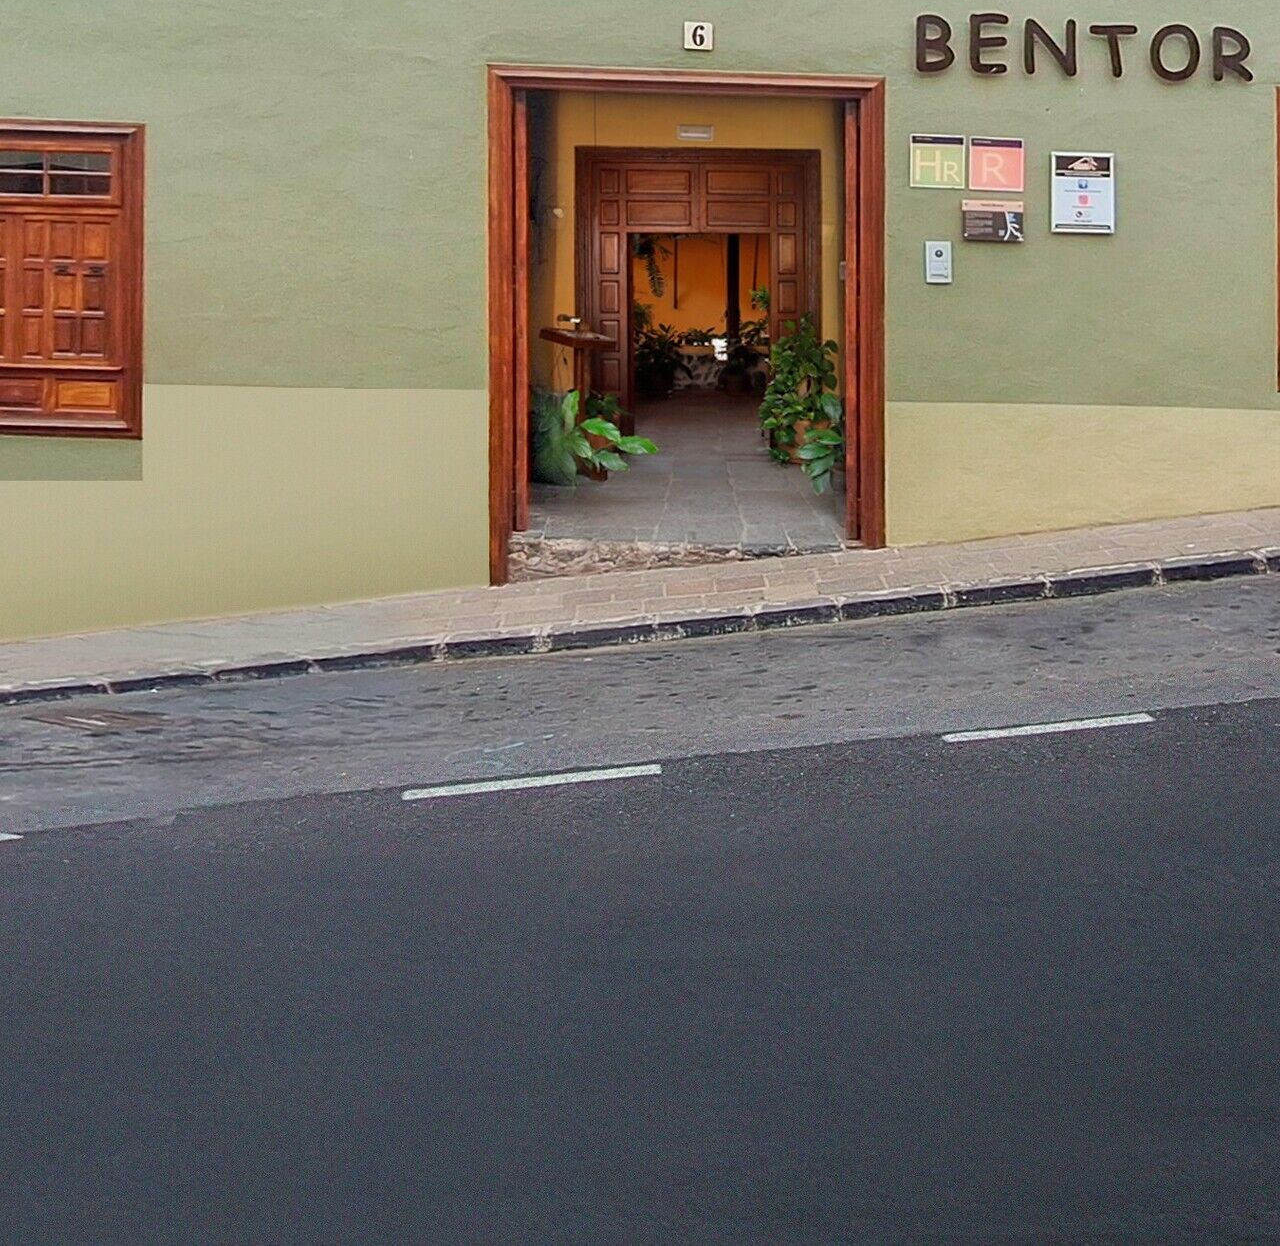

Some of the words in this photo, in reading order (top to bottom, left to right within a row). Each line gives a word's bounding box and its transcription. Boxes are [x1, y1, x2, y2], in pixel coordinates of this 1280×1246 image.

[692, 25, 705, 46] 6
[915, 13, 1254, 82] BENTOR
[981, 153, 1008, 184] R
